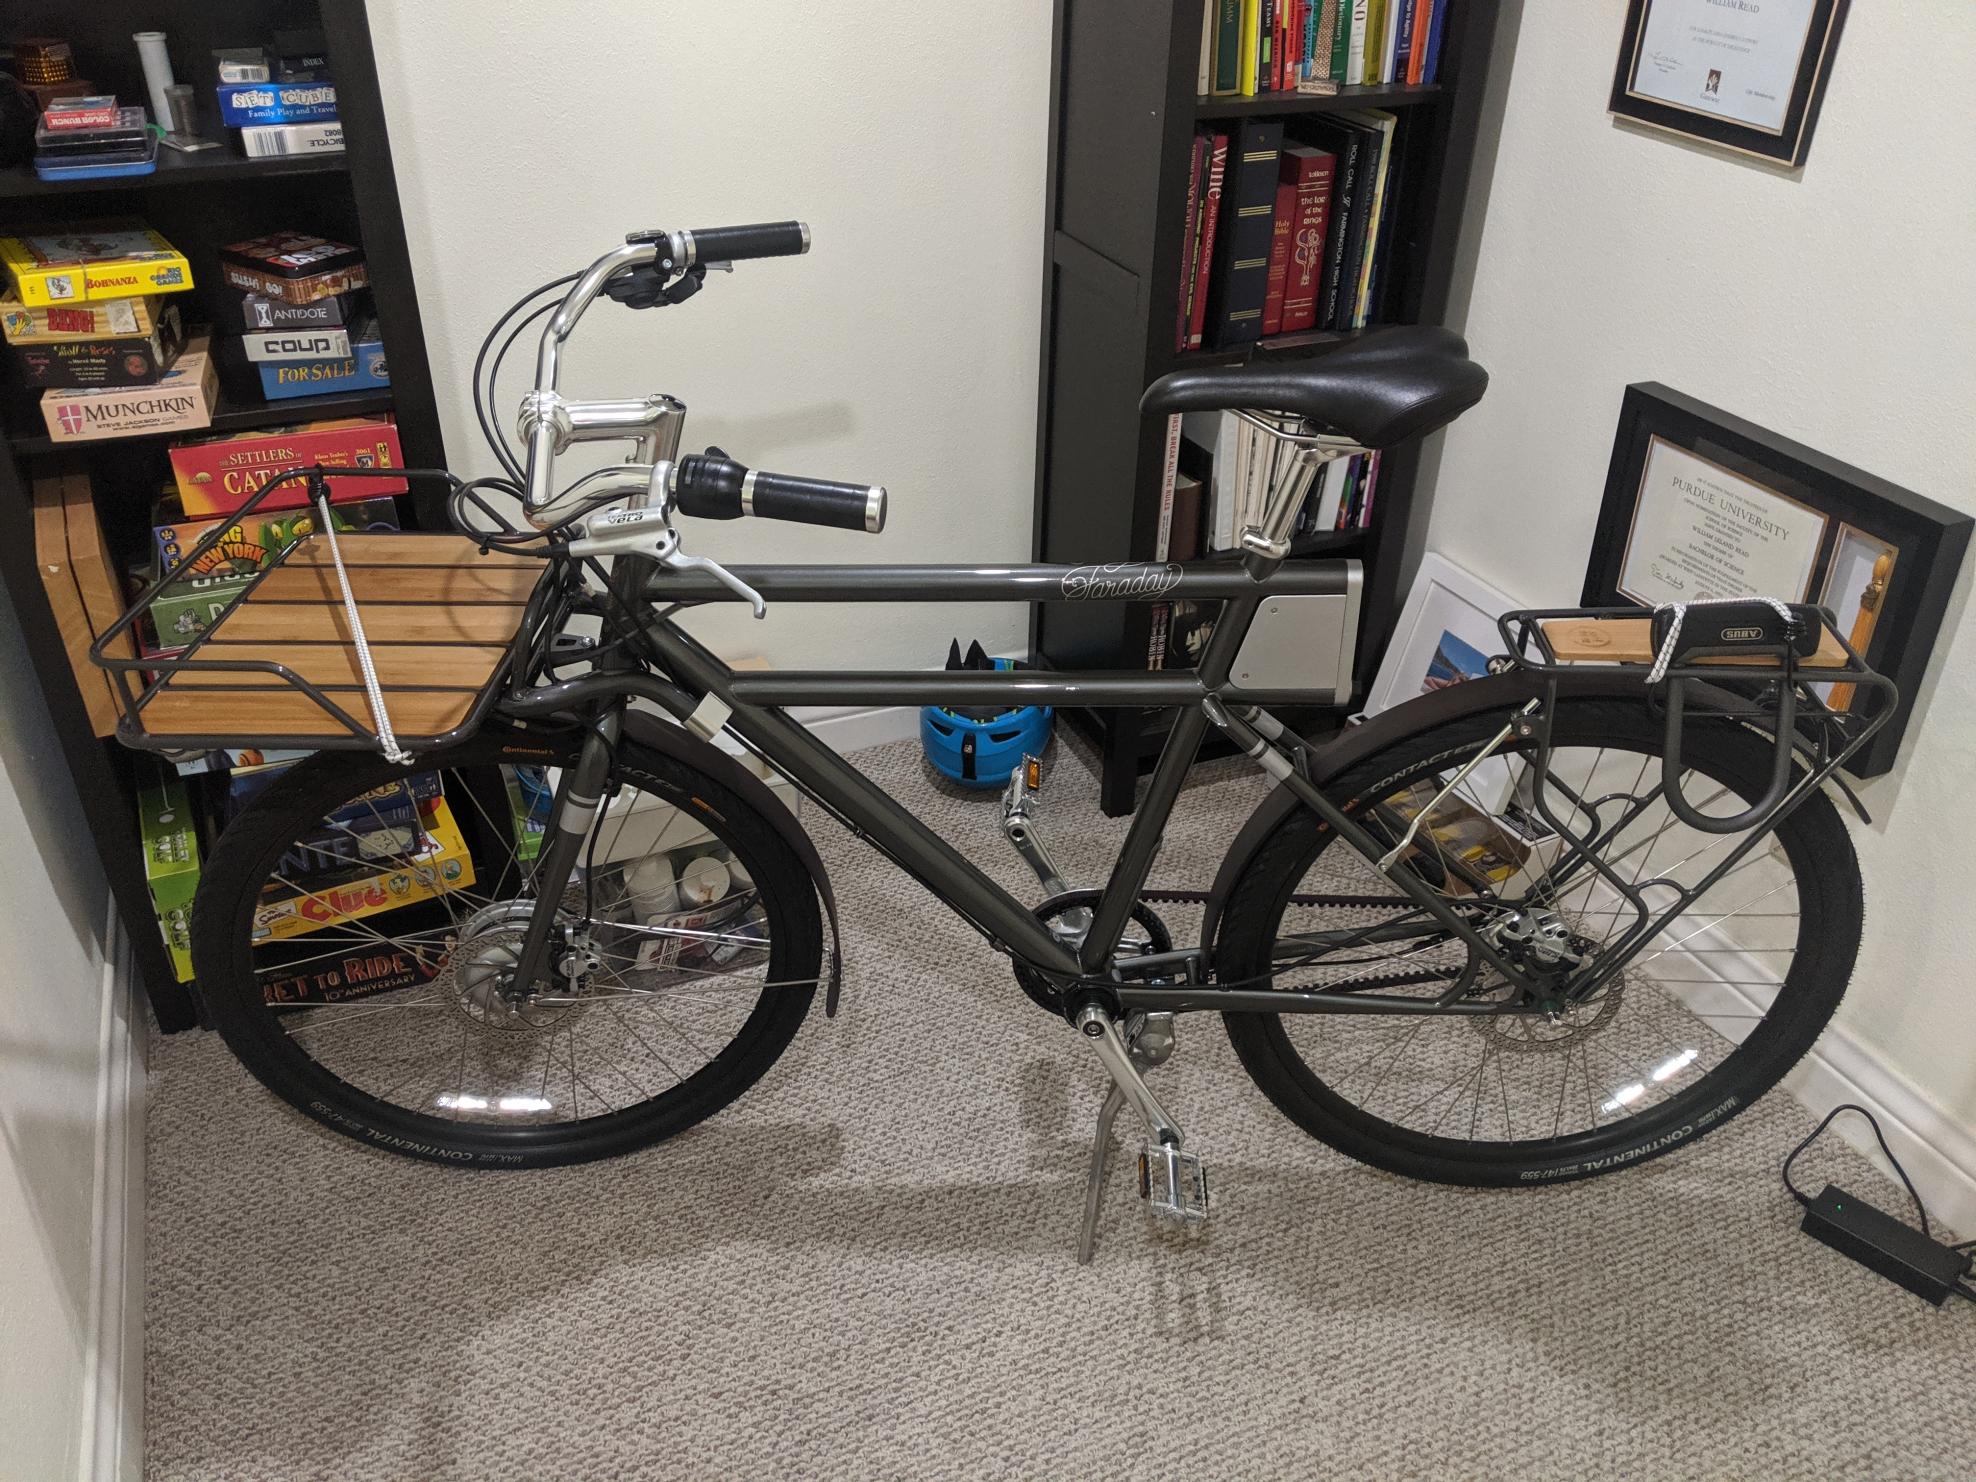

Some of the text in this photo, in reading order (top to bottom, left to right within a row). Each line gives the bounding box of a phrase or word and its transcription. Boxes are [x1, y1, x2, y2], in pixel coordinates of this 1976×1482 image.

[234, 90, 334, 107] SET CUBE
[248, 105, 337, 118] Family Play and Travel
[1346, 168, 1354, 190] CALL
[1210, 205, 1217, 218] AN
[1202, 219, 1215, 275] INTRODUCTION
[1336, 212, 1348, 264] FARMINGTON
[1332, 266, 1340, 286] HIGH
[273, 307, 328, 320] ANTIDOTE
[1327, 288, 1335, 320] SCHOOL
[278, 358, 357, 384] FOR SALE
[83, 396, 195, 422] MUNCHKIN
[96, 421, 122, 429] STEVE
[124, 418, 160, 426] JACKSON
[229, 447, 295, 466] SETTLERS
[1164, 490, 1172, 511] RULES
[1672, 476, 1717, 504] PURDUE
[1720, 498, 1790, 541] UNIVERSITY
[191, 542, 268, 575] NEW YORK
[1061, 563, 1183, 600] Faraday
[1725, 629, 1759, 639] ABUS
[1369, 750, 1453, 794] CONTACT
[301, 886, 389, 922] Clue
[263, 952, 412, 1003] KET TO RIDE
[345, 974, 416, 997] ANNIVERSARY
[366, 1127, 473, 1162] CONTINENTAL
[1583, 1124, 1694, 1172] CONTINENTAL
